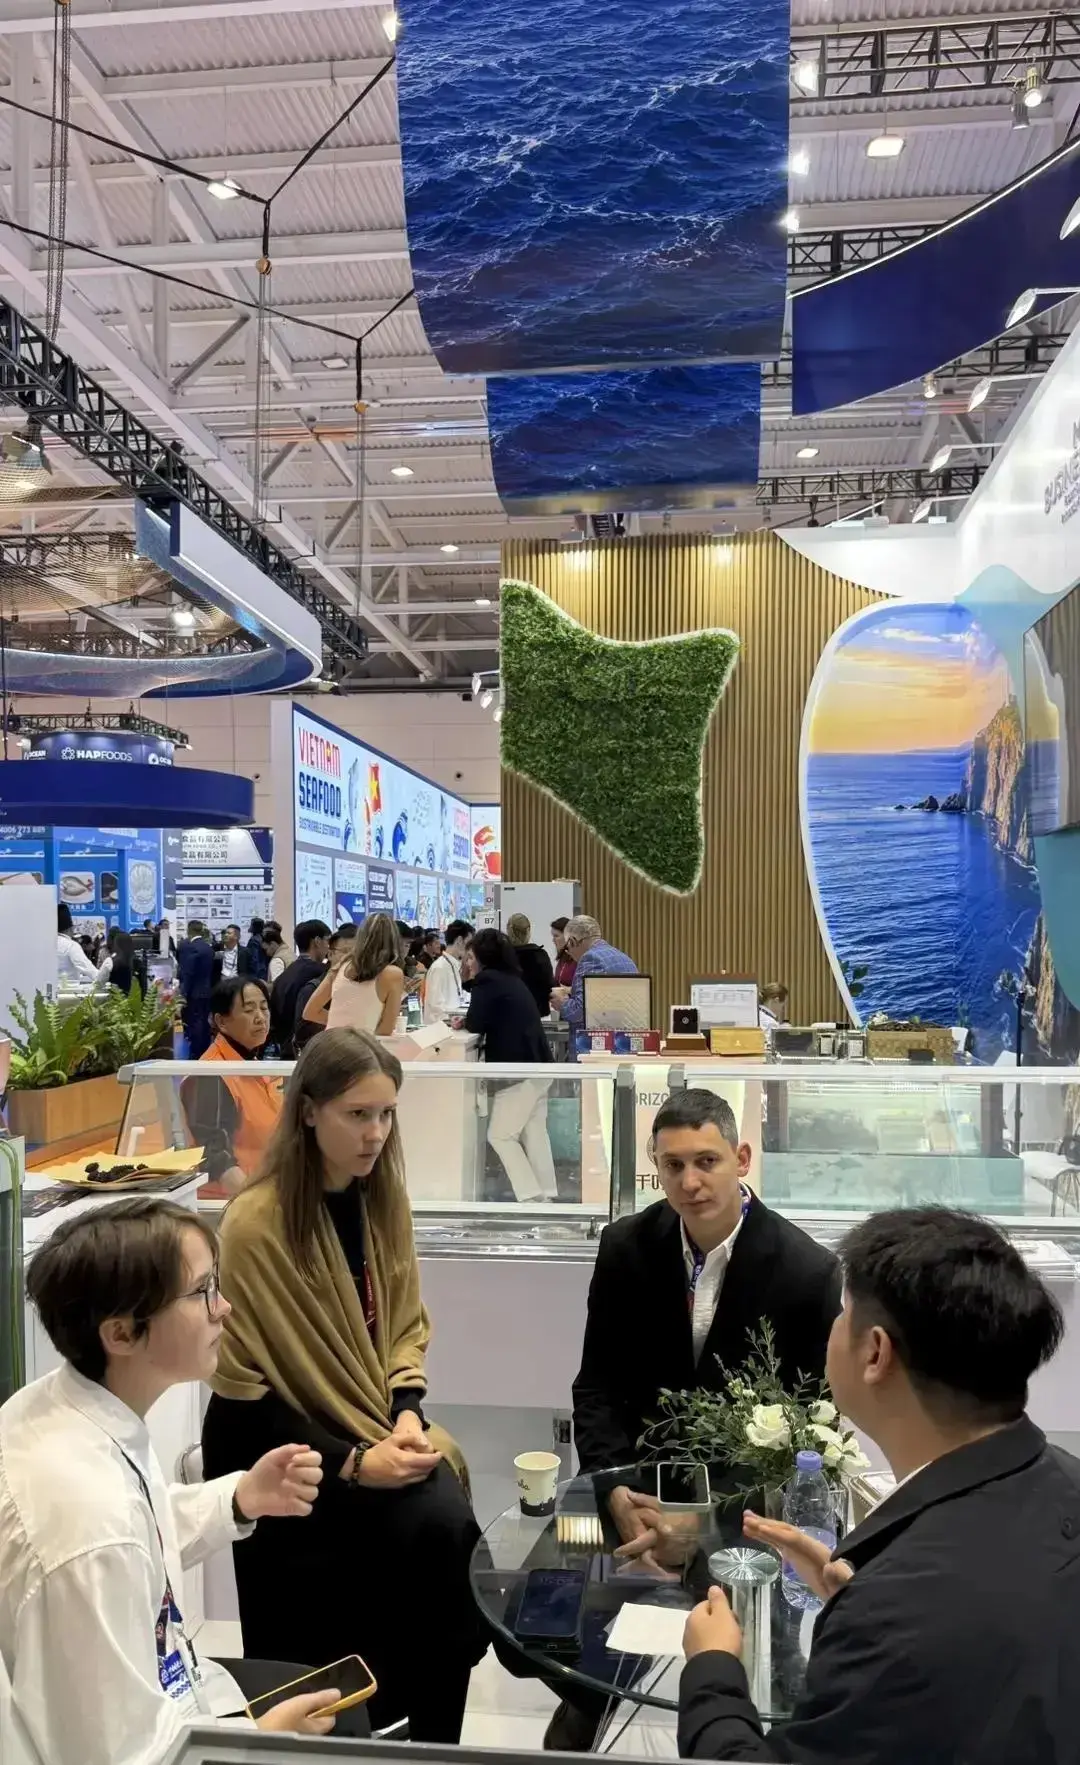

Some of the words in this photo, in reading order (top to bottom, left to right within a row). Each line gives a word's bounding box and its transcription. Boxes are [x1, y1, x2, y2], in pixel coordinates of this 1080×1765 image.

[76, 749, 133, 762] HAPFOODS
[298, 727, 341, 778] VIETNAM
[299, 771, 342, 818] SEAFOOD
